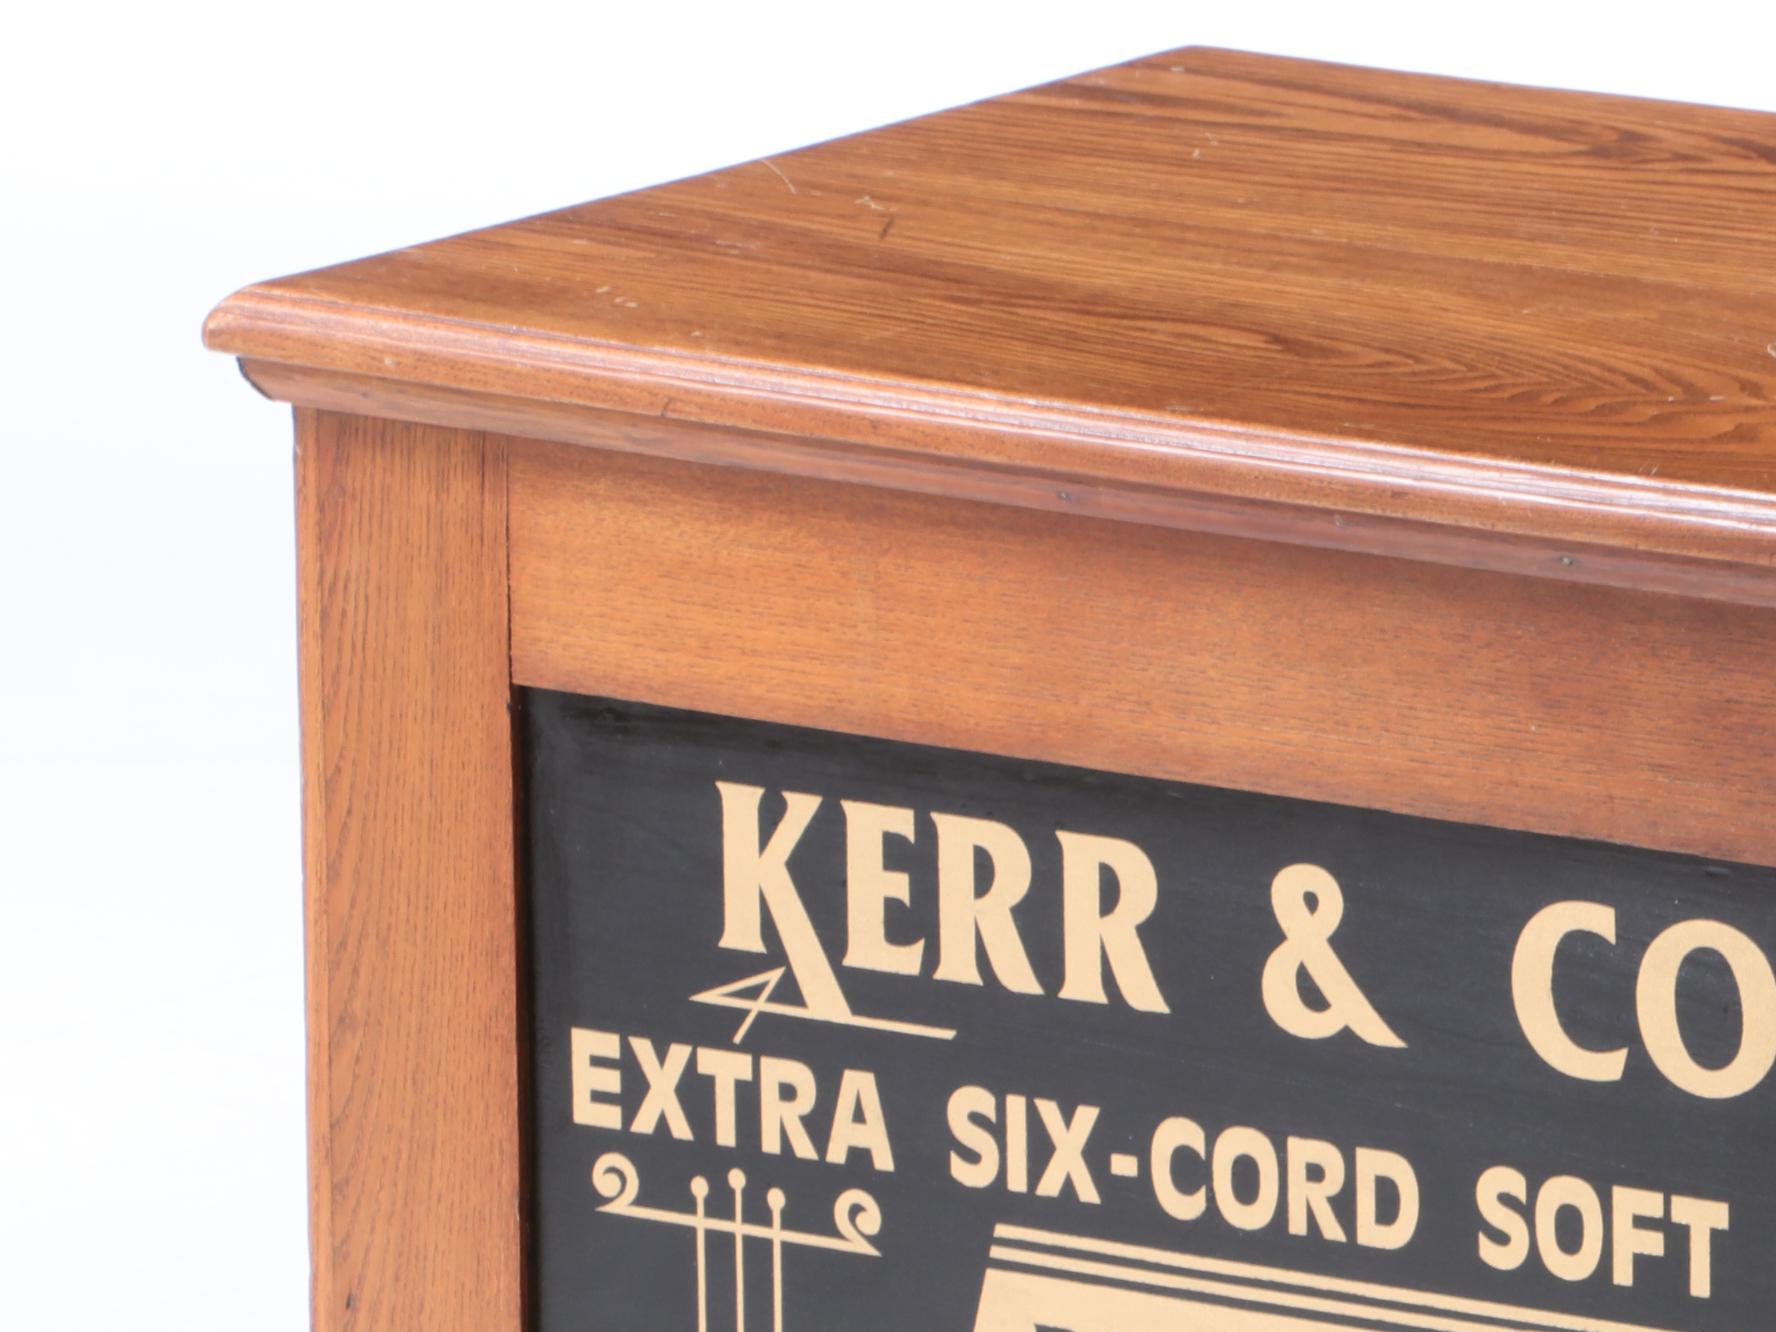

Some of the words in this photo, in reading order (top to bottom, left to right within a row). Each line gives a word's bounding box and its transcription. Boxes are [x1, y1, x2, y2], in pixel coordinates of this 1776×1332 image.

[714, 780, 1171, 1020] KERR
[1260, 862, 1409, 1049] &
[570, 1026, 896, 1173] EXTRA
[945, 1084, 1421, 1251] SIX-CORD
[1474, 1164, 1730, 1299] SOFT
